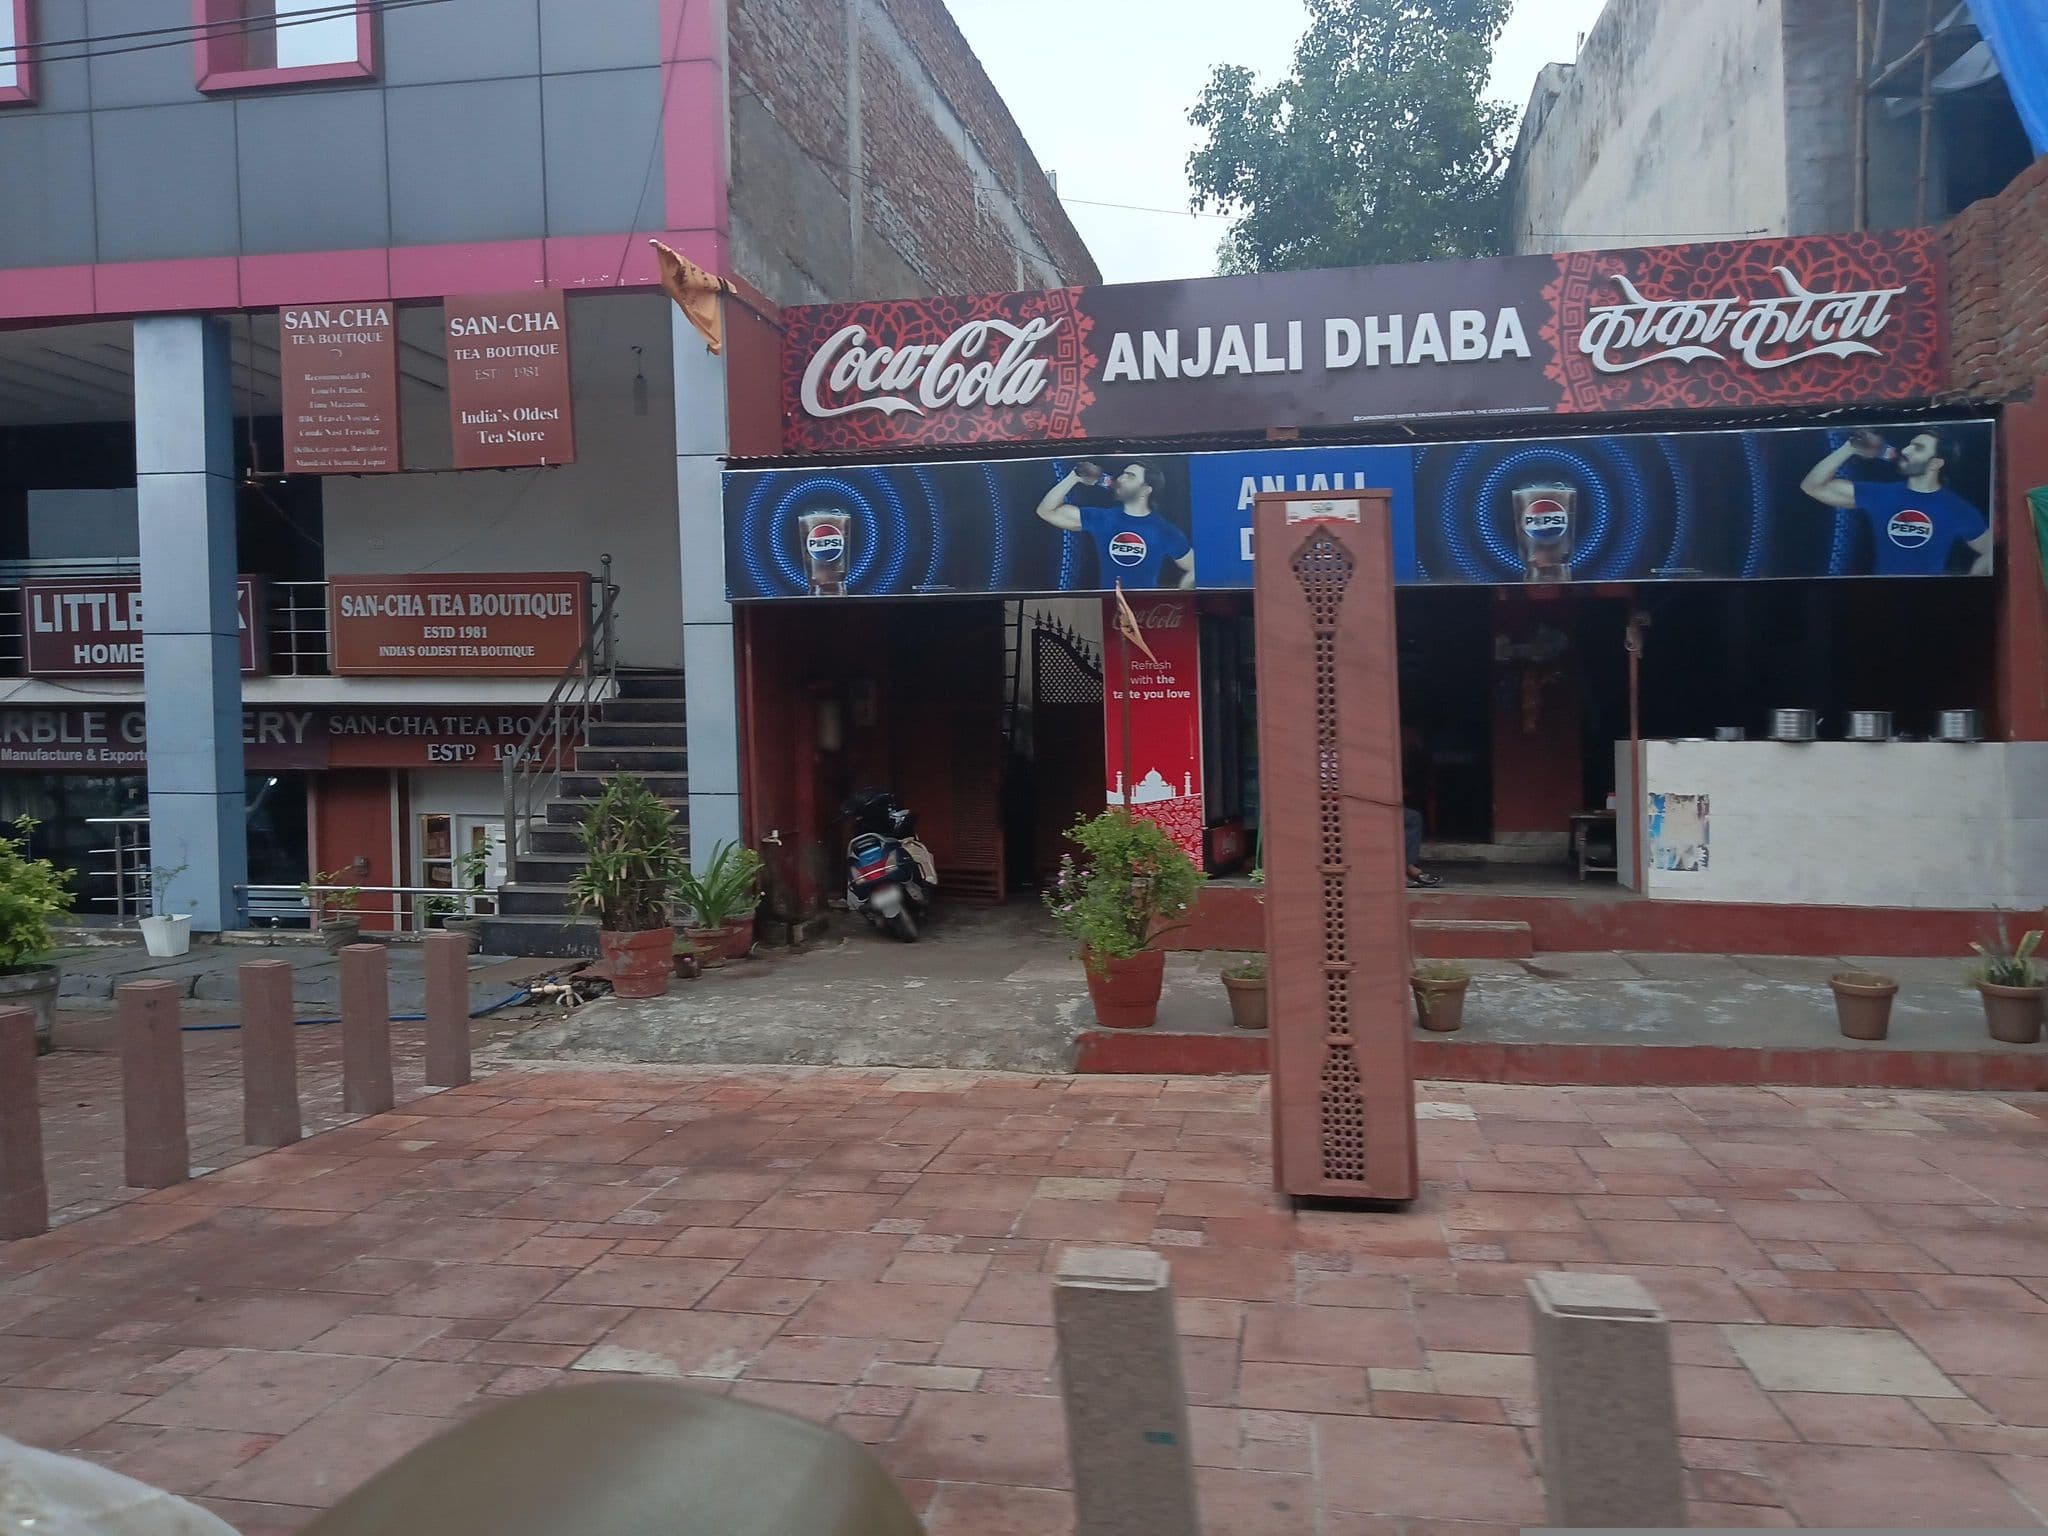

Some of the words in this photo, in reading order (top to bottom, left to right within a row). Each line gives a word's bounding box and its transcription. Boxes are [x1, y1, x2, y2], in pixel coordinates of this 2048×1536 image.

[284, 308, 389, 330] SAN-CHA
[450, 312, 560, 337] SAN-CHA
[1579, 266, 1907, 373] कोका-कोला
[291, 335, 315, 345] TEA
[319, 333, 384, 345] BOUTIQUE
[1102, 320, 1303, 382] ANJALI
[1325, 307, 1531, 369] DHABA
[454, 349, 480, 360] TEA
[486, 344, 559, 359] BOUTIQUE
[800, 317, 1064, 418] Coca-Cola
[461, 408, 509, 424] India's
[513, 407, 560, 421] Oldest
[477, 430, 504, 444] Tea
[507, 429, 545, 443] Store
[1892, 523, 1930, 535] PEPSI
[1112, 543, 1144, 554] PEPSI
[33, 592, 144, 633] LITTLE
[341, 594, 426, 618] SAN-CHA
[427, 594, 466, 617] TEA
[469, 593, 573, 619] BOUTIQUE
[423, 626, 455, 639] ESTD
[459, 626, 488, 639] 1981
[417, 646, 458, 657] OLDEST
[458, 646, 480, 657] TEA
[481, 646, 535, 658] BOUTIQUE
[1131, 660, 1171, 670] Refresh
[1130, 675, 1153, 684] with
[1156, 674, 1175, 684] the
[1113, 689, 1141, 699] tate
[1143, 690, 1163, 700] you
[1166, 688, 1190, 699] love
[0, 712, 108, 744] RBLE
[121, 711, 313, 744] GERY
[329, 715, 439, 736] SAN-CHA
[442, 716, 492, 736] TEA
[2, 748, 82, 761] Manufacture
[86, 748, 97, 761] &
